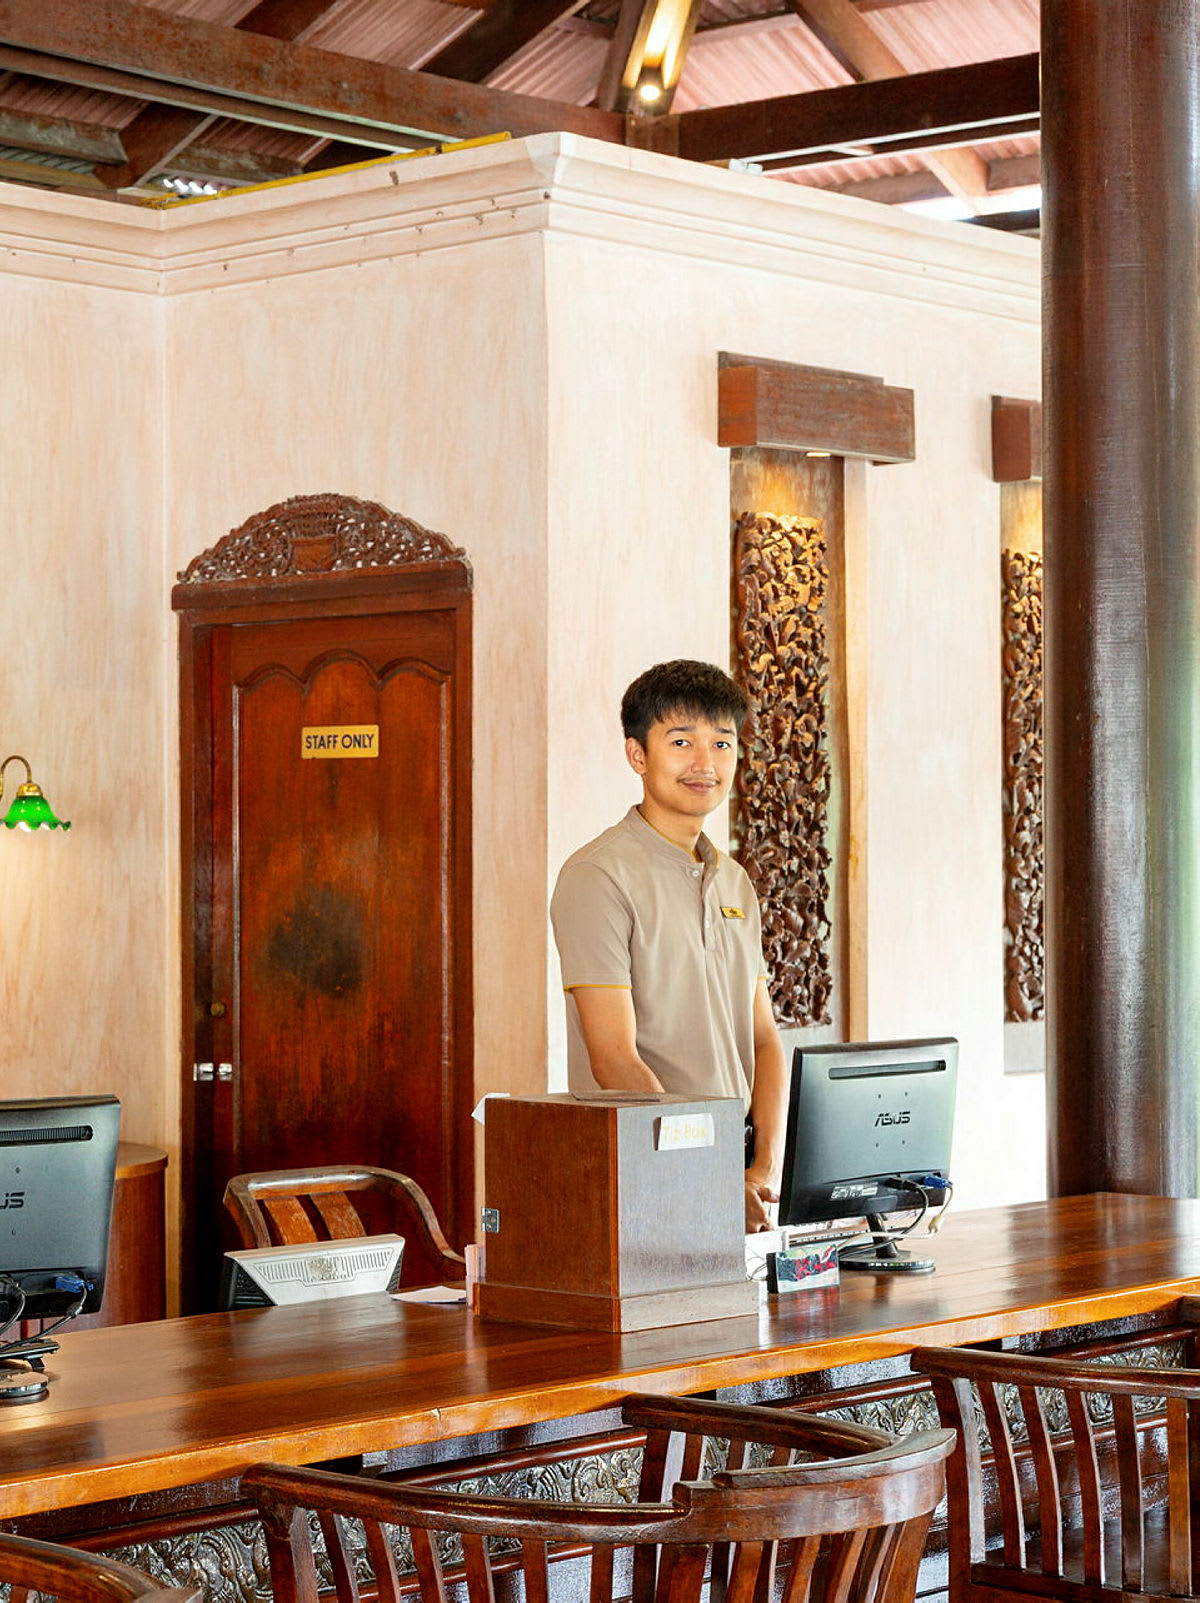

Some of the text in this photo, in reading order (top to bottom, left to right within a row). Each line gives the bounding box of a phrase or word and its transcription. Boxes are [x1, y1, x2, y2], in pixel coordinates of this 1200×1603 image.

[305, 734, 374, 749] STAFF ONLY
[874, 1110, 911, 1127] ASUS
